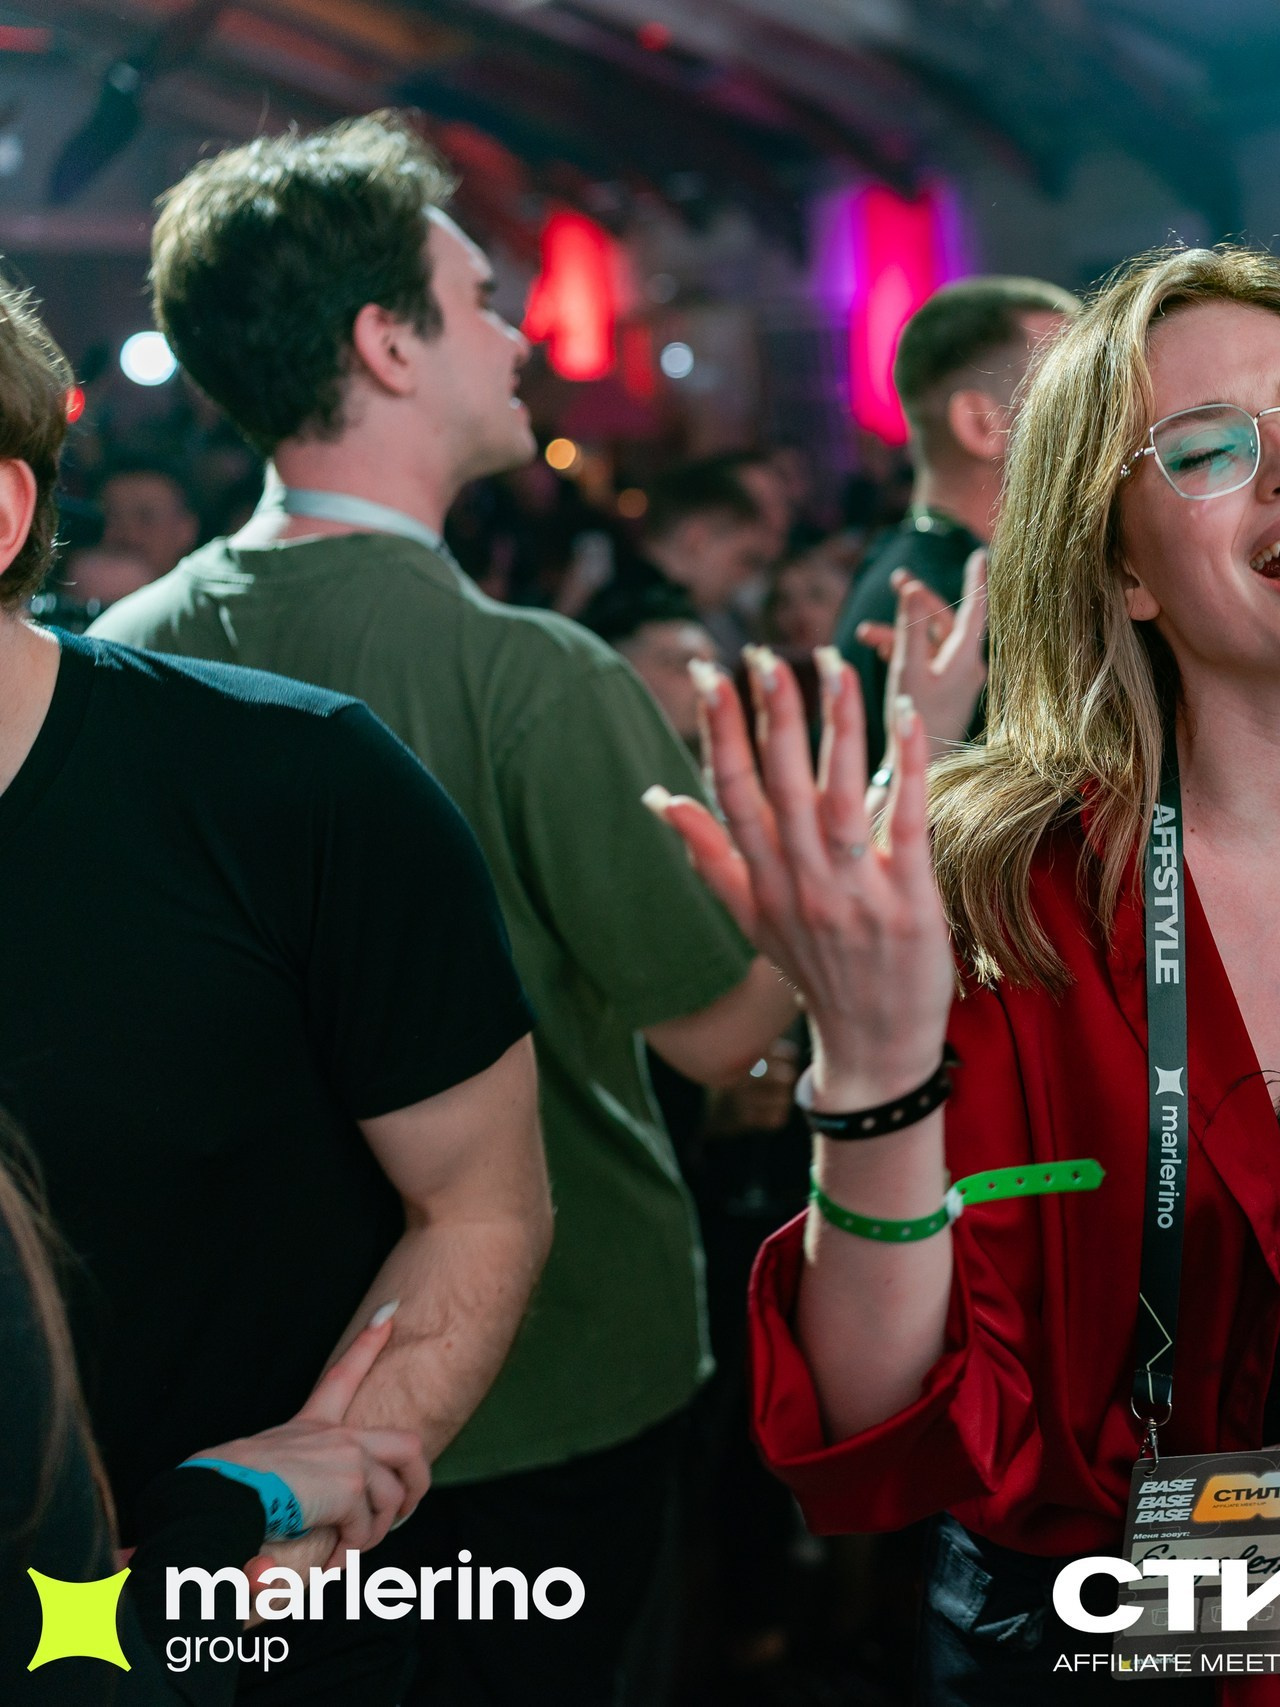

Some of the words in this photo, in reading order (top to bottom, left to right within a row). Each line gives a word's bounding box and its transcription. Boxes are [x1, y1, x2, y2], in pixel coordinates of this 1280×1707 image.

[1153, 802, 1180, 985] AFFSTYLE
[1157, 1104, 1182, 1230] marlerino
[1138, 1478, 1197, 1494] BASE
[1136, 1494, 1195, 1509] BASE
[1134, 1508, 1193, 1524] BASE
[1160, 1531, 1191, 1539] зовут:
